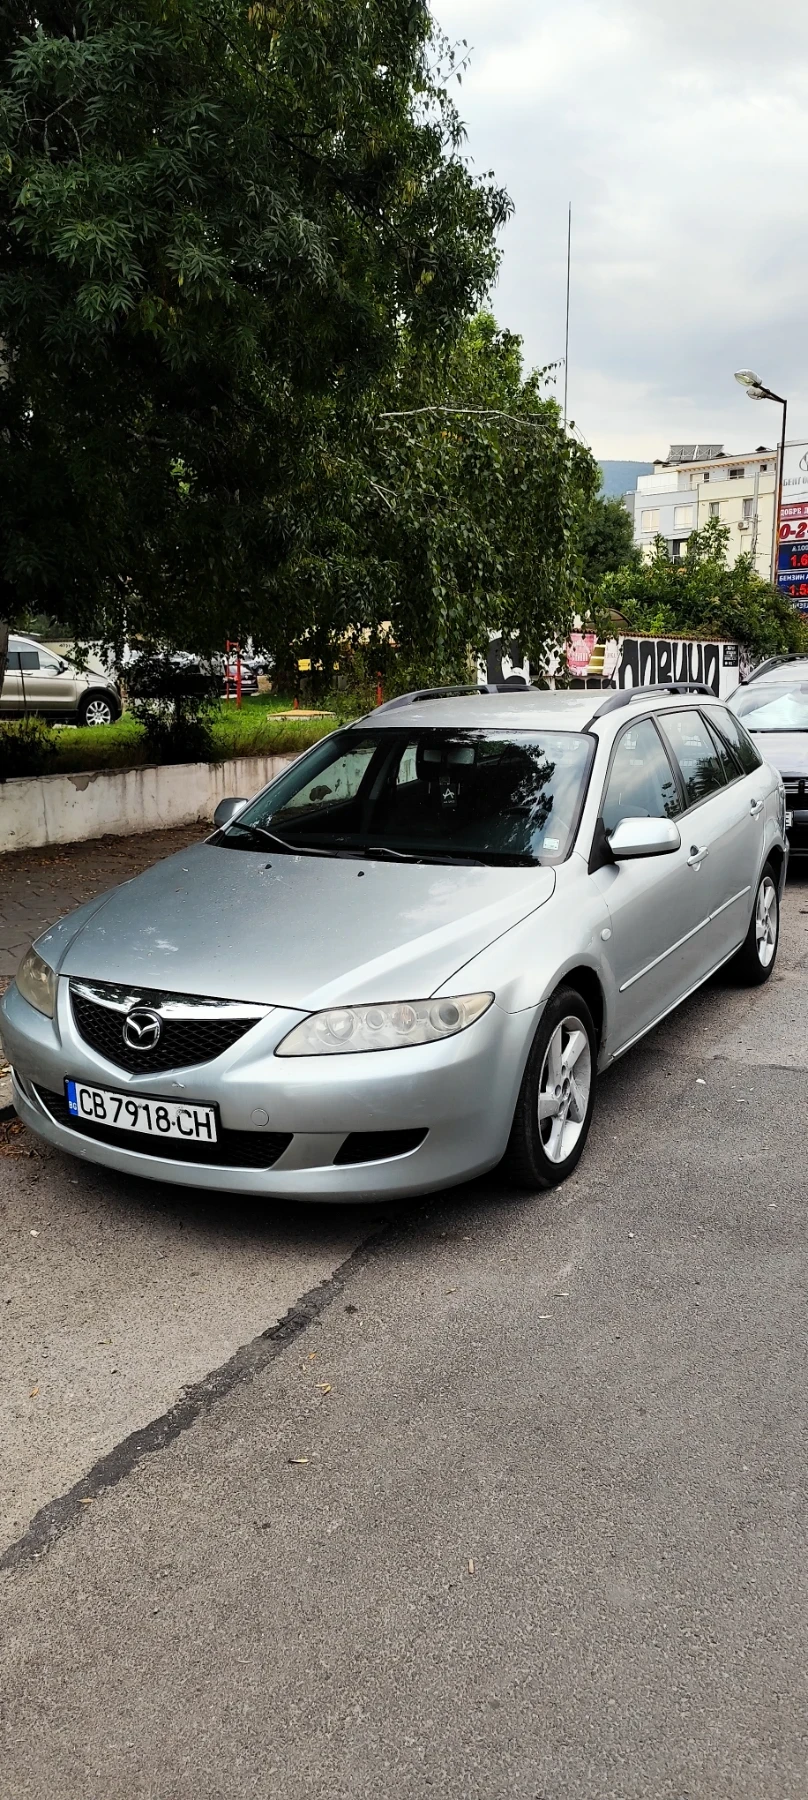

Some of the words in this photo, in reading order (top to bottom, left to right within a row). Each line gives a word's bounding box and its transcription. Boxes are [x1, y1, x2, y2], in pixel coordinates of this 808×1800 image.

[779, 574, 805, 582] БЕНЗИН
[68, 1100, 78, 1111] BG
[109, 1097, 171, 1133] 7918
